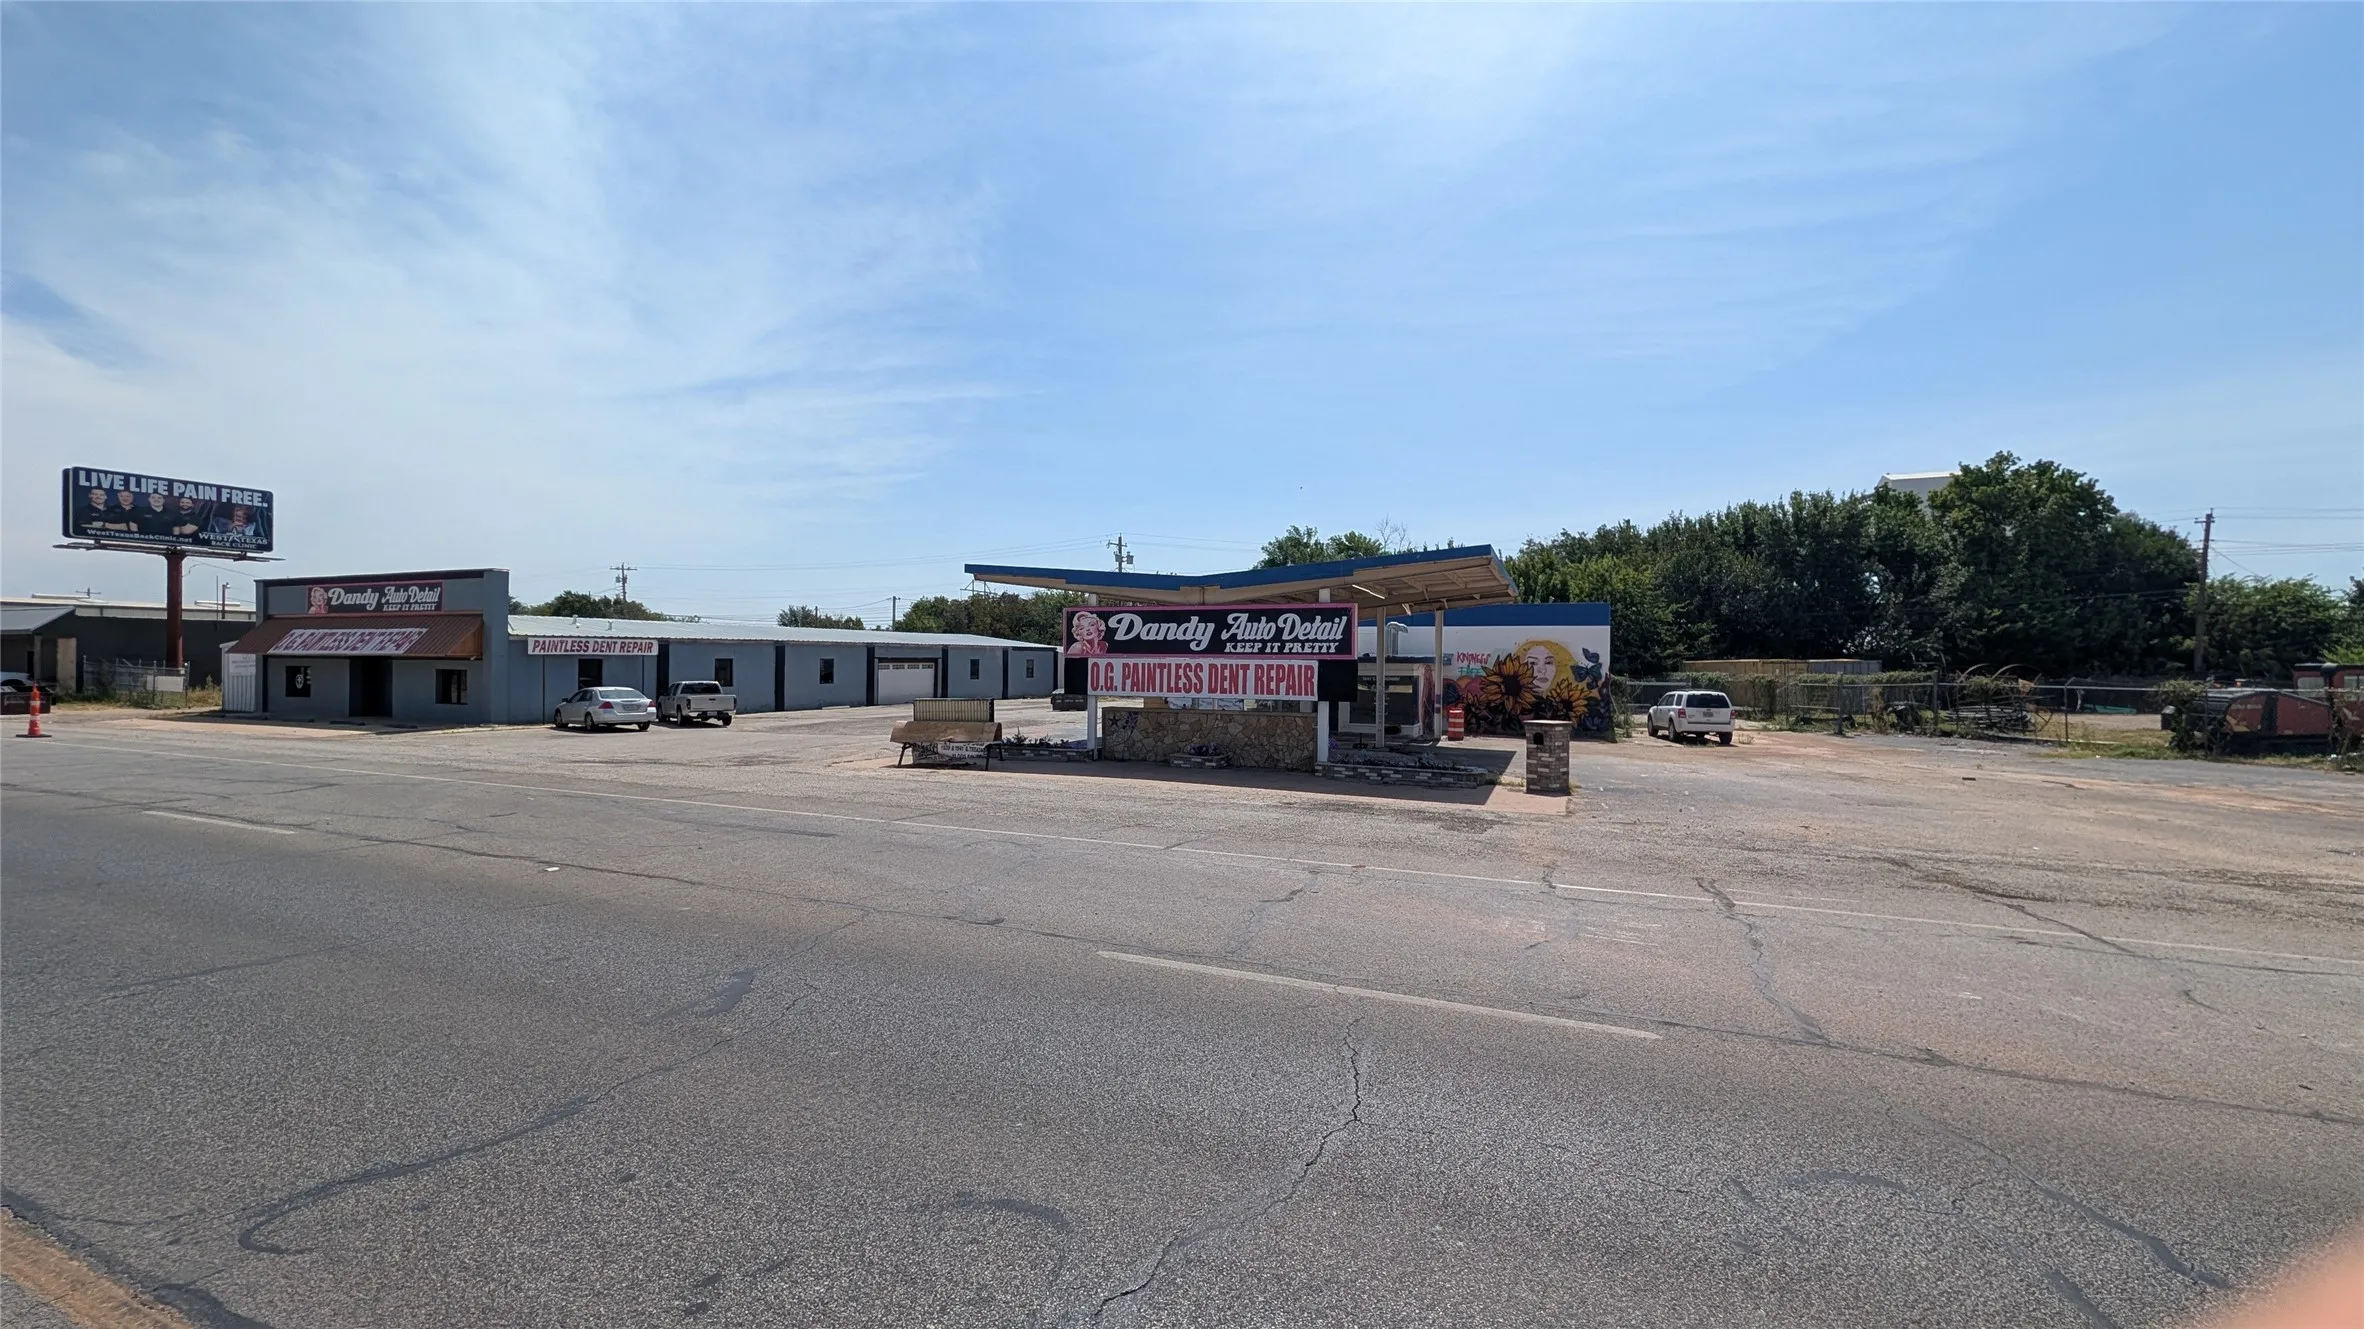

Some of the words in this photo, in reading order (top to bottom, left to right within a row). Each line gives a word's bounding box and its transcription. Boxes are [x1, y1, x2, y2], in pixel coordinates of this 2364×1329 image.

[78, 470, 124, 490] LIVE
[129, 476, 169, 496] LIFE
[173, 482, 217, 501] PAIN
[221, 488, 268, 507] FREE.
[328, 587, 380, 611] Dandy
[381, 586, 407, 604] Auto
[408, 585, 441, 603] Detail
[382, 603, 402, 612] KEEP
[402, 603, 409, 611] IT
[410, 603, 437, 611] PRETTY
[1107, 613, 1215, 651] Dandy
[1220, 613, 1276, 641] Auto
[1278, 613, 1347, 641] Detail
[532, 639, 590, 653] PAINTLESS
[592, 640, 618, 653] DENT
[619, 641, 653, 654] REPAIR
[1224, 642, 1262, 653] KEEP
[1265, 642, 1280, 653] IT
[1282, 642, 1339, 653] PRETTY
[1090, 661, 1118, 692] O.G.
[1122, 661, 1204, 694] PAINTLESS
[1208, 663, 1250, 695] DENT
[1254, 663, 1315, 697] REPAIR
